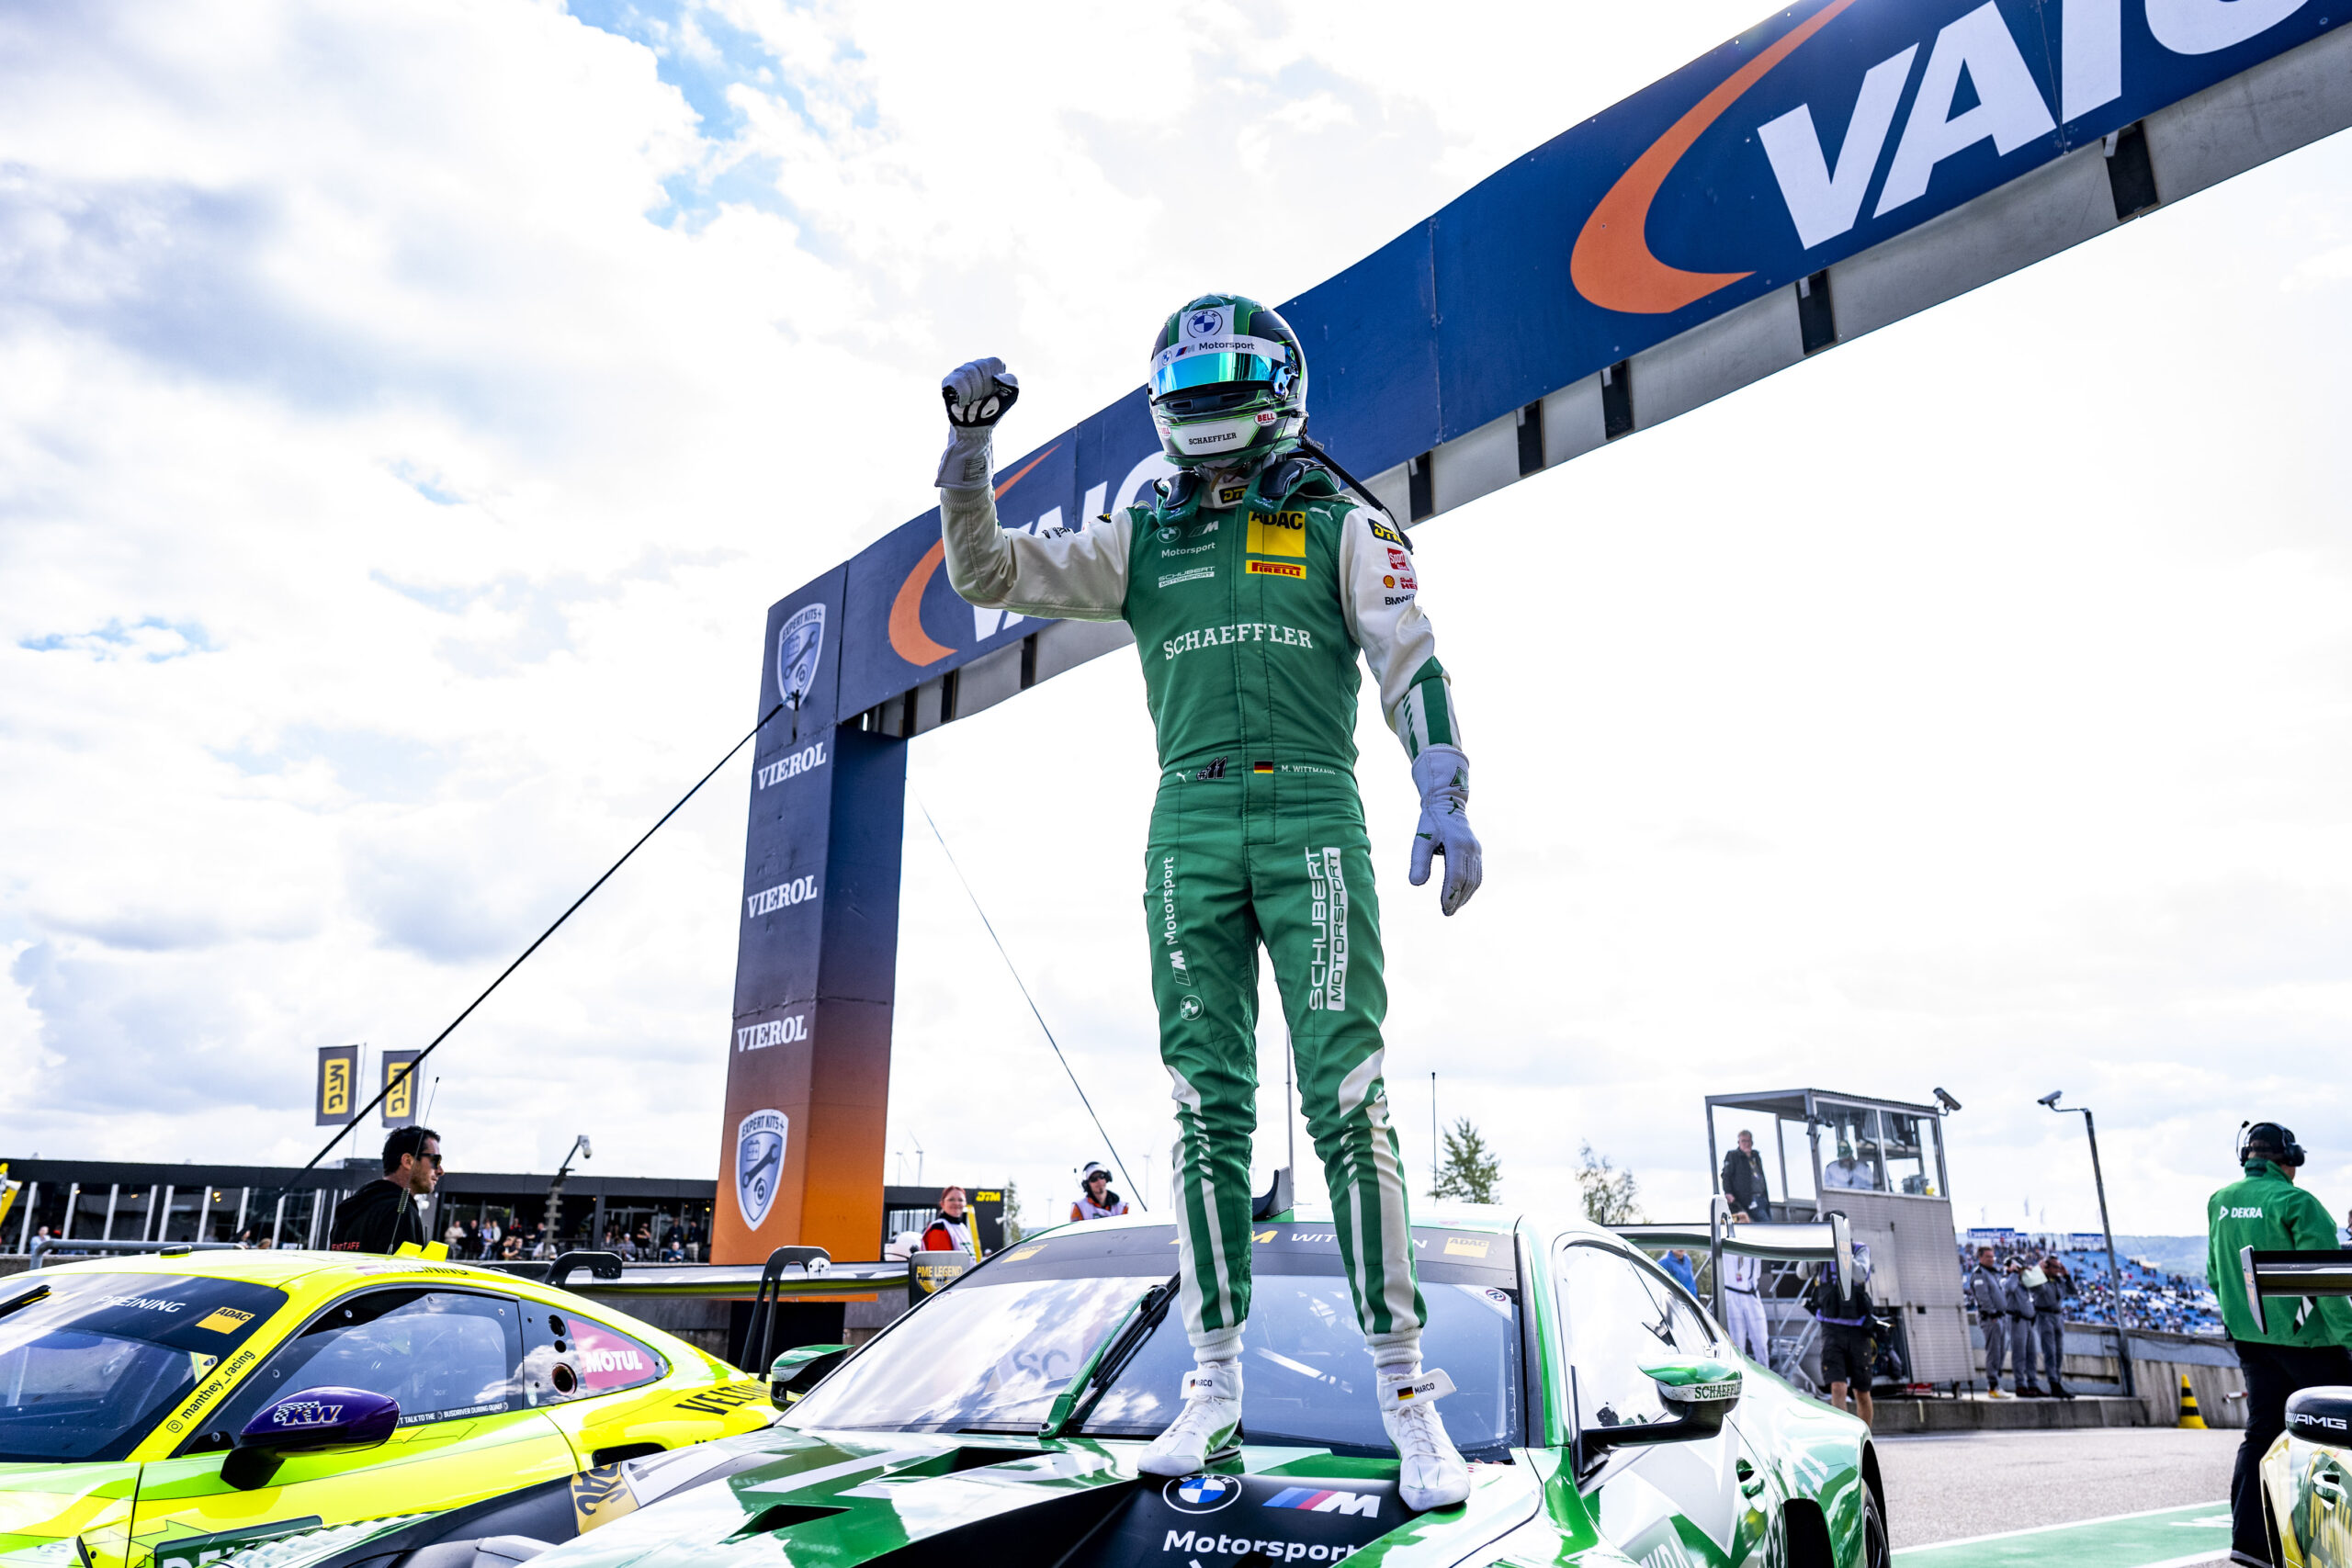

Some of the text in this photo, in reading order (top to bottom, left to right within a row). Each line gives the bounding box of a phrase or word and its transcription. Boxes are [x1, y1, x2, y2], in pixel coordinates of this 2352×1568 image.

[1199, 341, 1255, 351] Motorsport
[1257, 412, 1275, 423] BELL
[1188, 433, 1238, 446] SCHAEFFLER
[1250, 512, 1304, 530] ADAC
[1161, 542, 1216, 558] Motorsport
[1158, 566, 1216, 581] SCHUBERT
[1251, 561, 1302, 577] PIRELLI
[1159, 571, 1215, 588] MOTORSPORT
[782, 615, 805, 641] EXPERT
[1162, 623, 1314, 660] SCHAEFFLER
[758, 741, 827, 790] VIEROL
[1281, 764, 1291, 773] M.
[747, 874, 818, 919] VIEROL
[1163, 856, 1179, 946] Motorsport
[1305, 846, 1329, 1010] SCHUBERT
[1328, 852, 1344, 1002] MOTORSPORT
[737, 1015, 808, 1053] VIEROL
[741, 1118, 764, 1138] EXPERT
[976, 1191, 1001, 1201] DTM
[2231, 1207, 2263, 1218] DEKRA
[1448, 1237, 1488, 1247] ADAC
[916, 1266, 964, 1278] PME LEGEND
[92, 1294, 187, 1314] PREINING
[215, 1307, 252, 1322] ADAC
[585, 1349, 643, 1373] MOTUL
[180, 1349, 256, 1420] manthey_racing
[1413, 1382, 1436, 1395] MARCO
[1694, 1382, 1742, 1399] SCHAEFFLE
[284, 1404, 343, 1426] KW
[404, 1416, 419, 1424] TALK
[424, 1413, 436, 1421] THE
[2294, 1415, 2347, 1430] AMG
